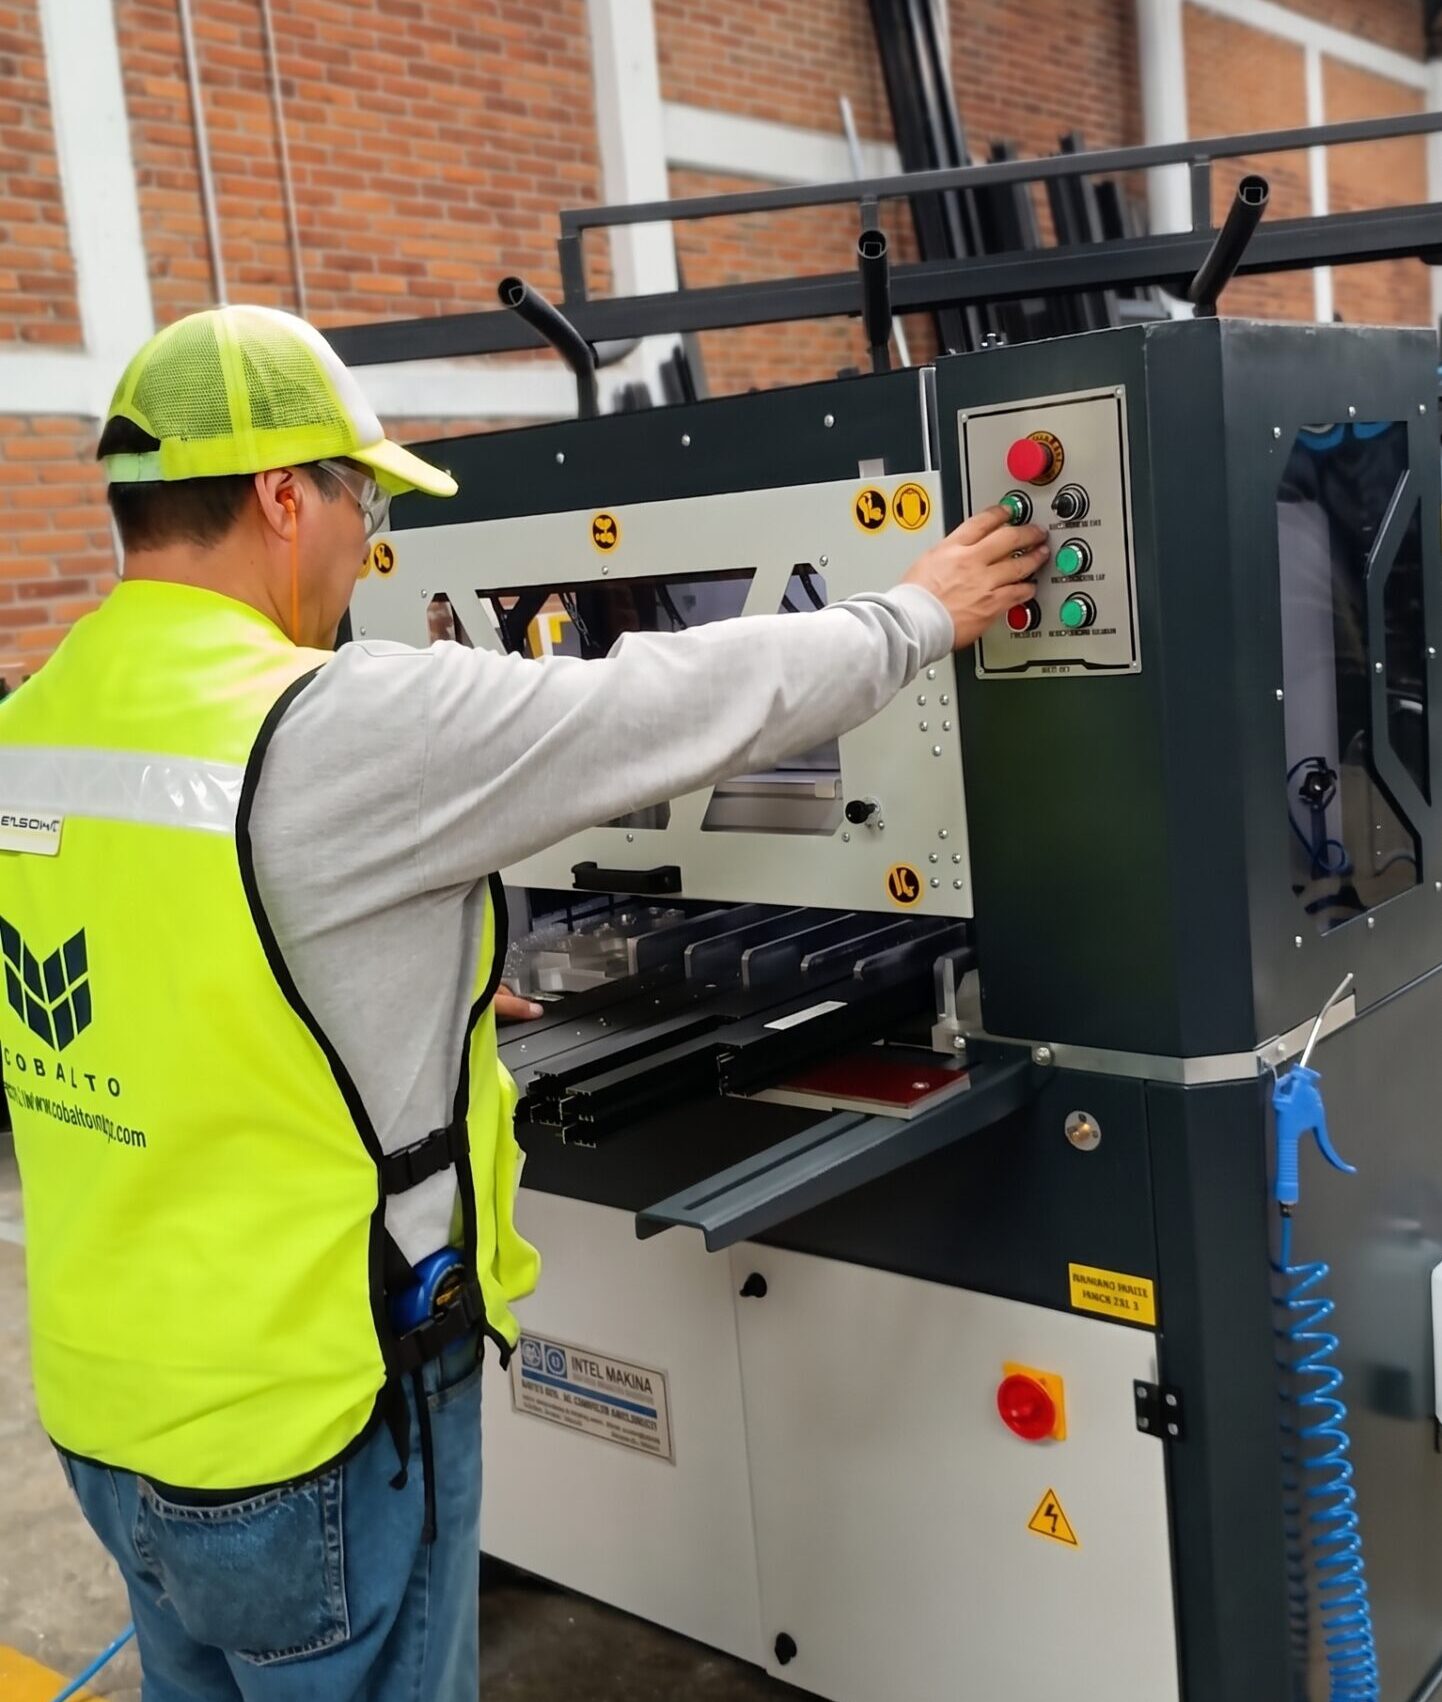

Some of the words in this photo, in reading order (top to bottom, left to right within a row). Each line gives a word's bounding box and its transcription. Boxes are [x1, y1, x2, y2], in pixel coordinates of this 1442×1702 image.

[4, 1047, 121, 1098] COBALTO
[571, 1355, 604, 1381] INTEL
[605, 1366, 653, 1395] MAKINA
